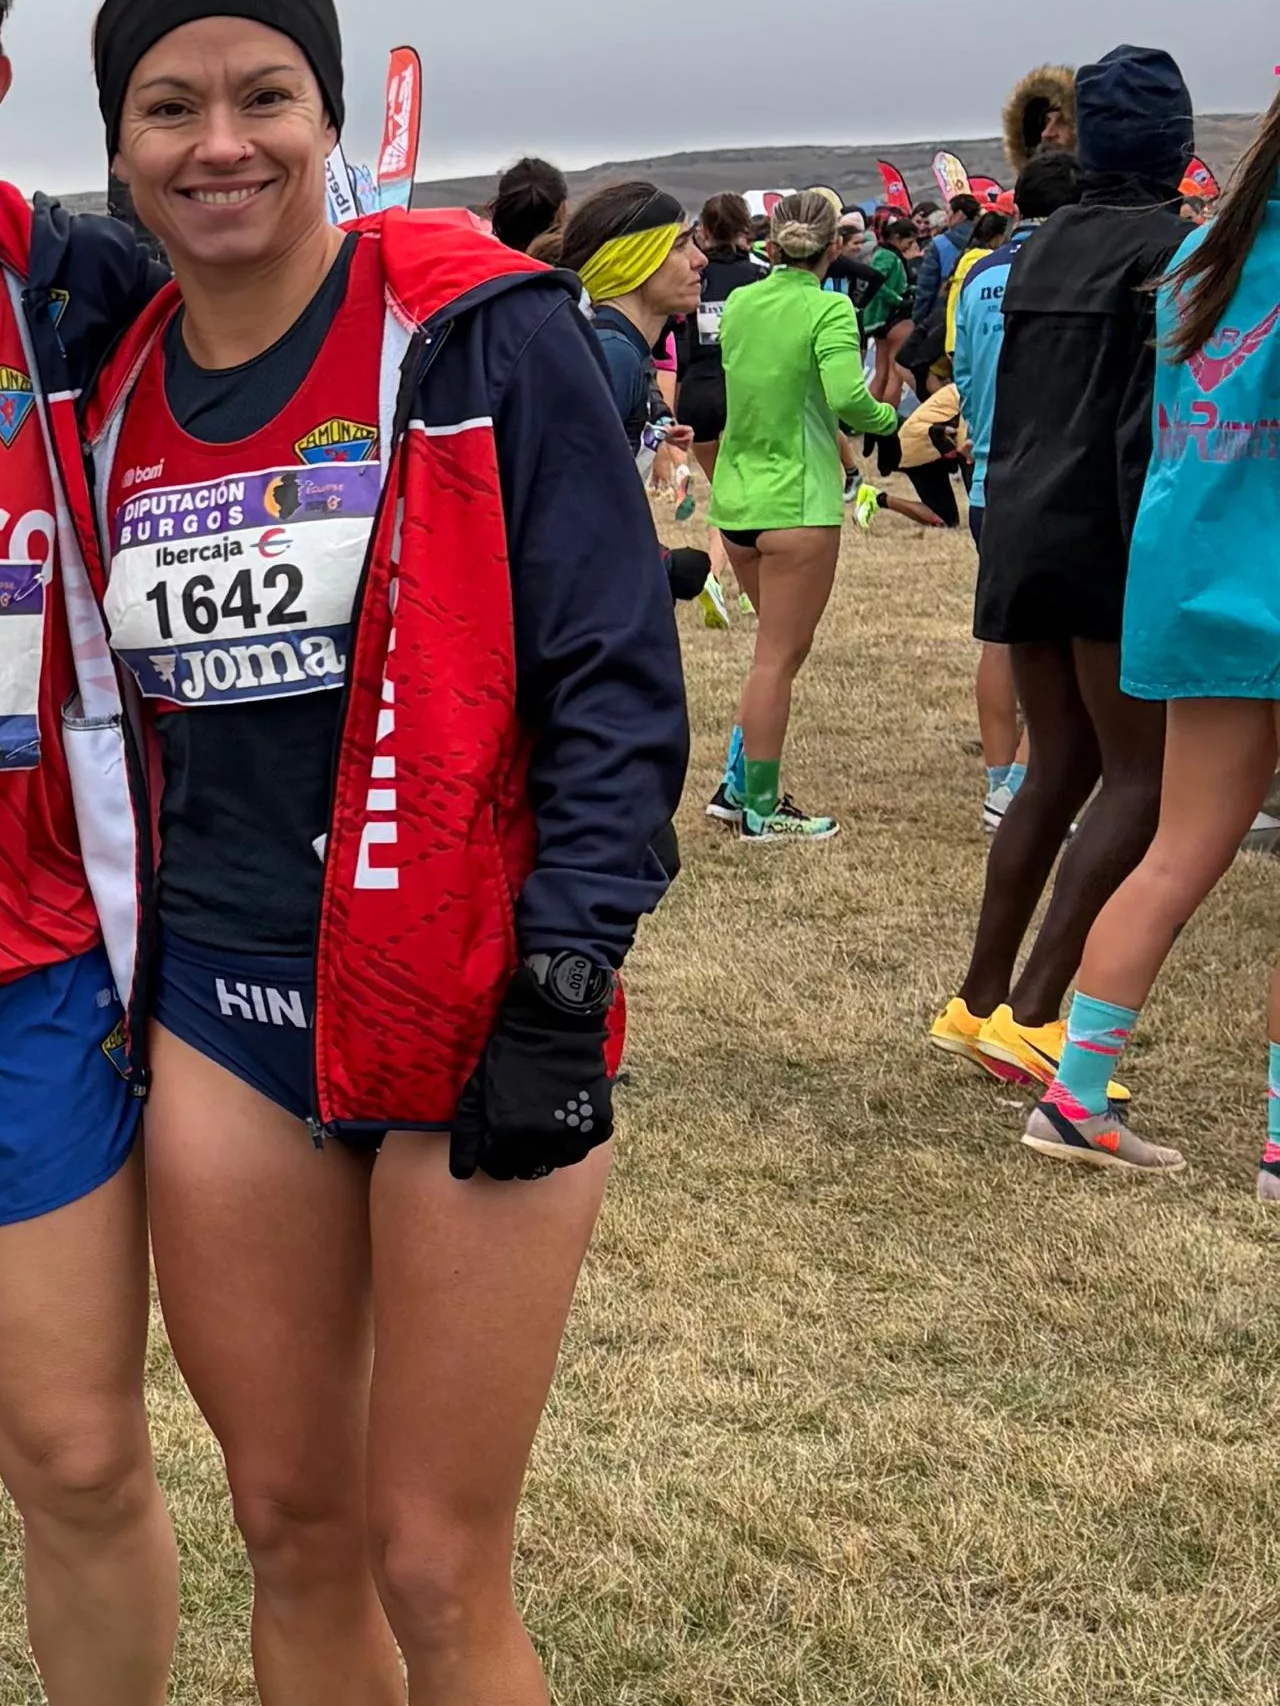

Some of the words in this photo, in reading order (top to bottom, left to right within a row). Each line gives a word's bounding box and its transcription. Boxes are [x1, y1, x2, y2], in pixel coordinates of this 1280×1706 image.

[135, 458, 165, 484] barri
[124, 480, 245, 523] DIPUTACIÓN
[120, 505, 244, 545] BURGOS
[156, 536, 243, 568] Ibercaja
[146, 563, 307, 640] 1642
[180, 635, 346, 699] Joma
